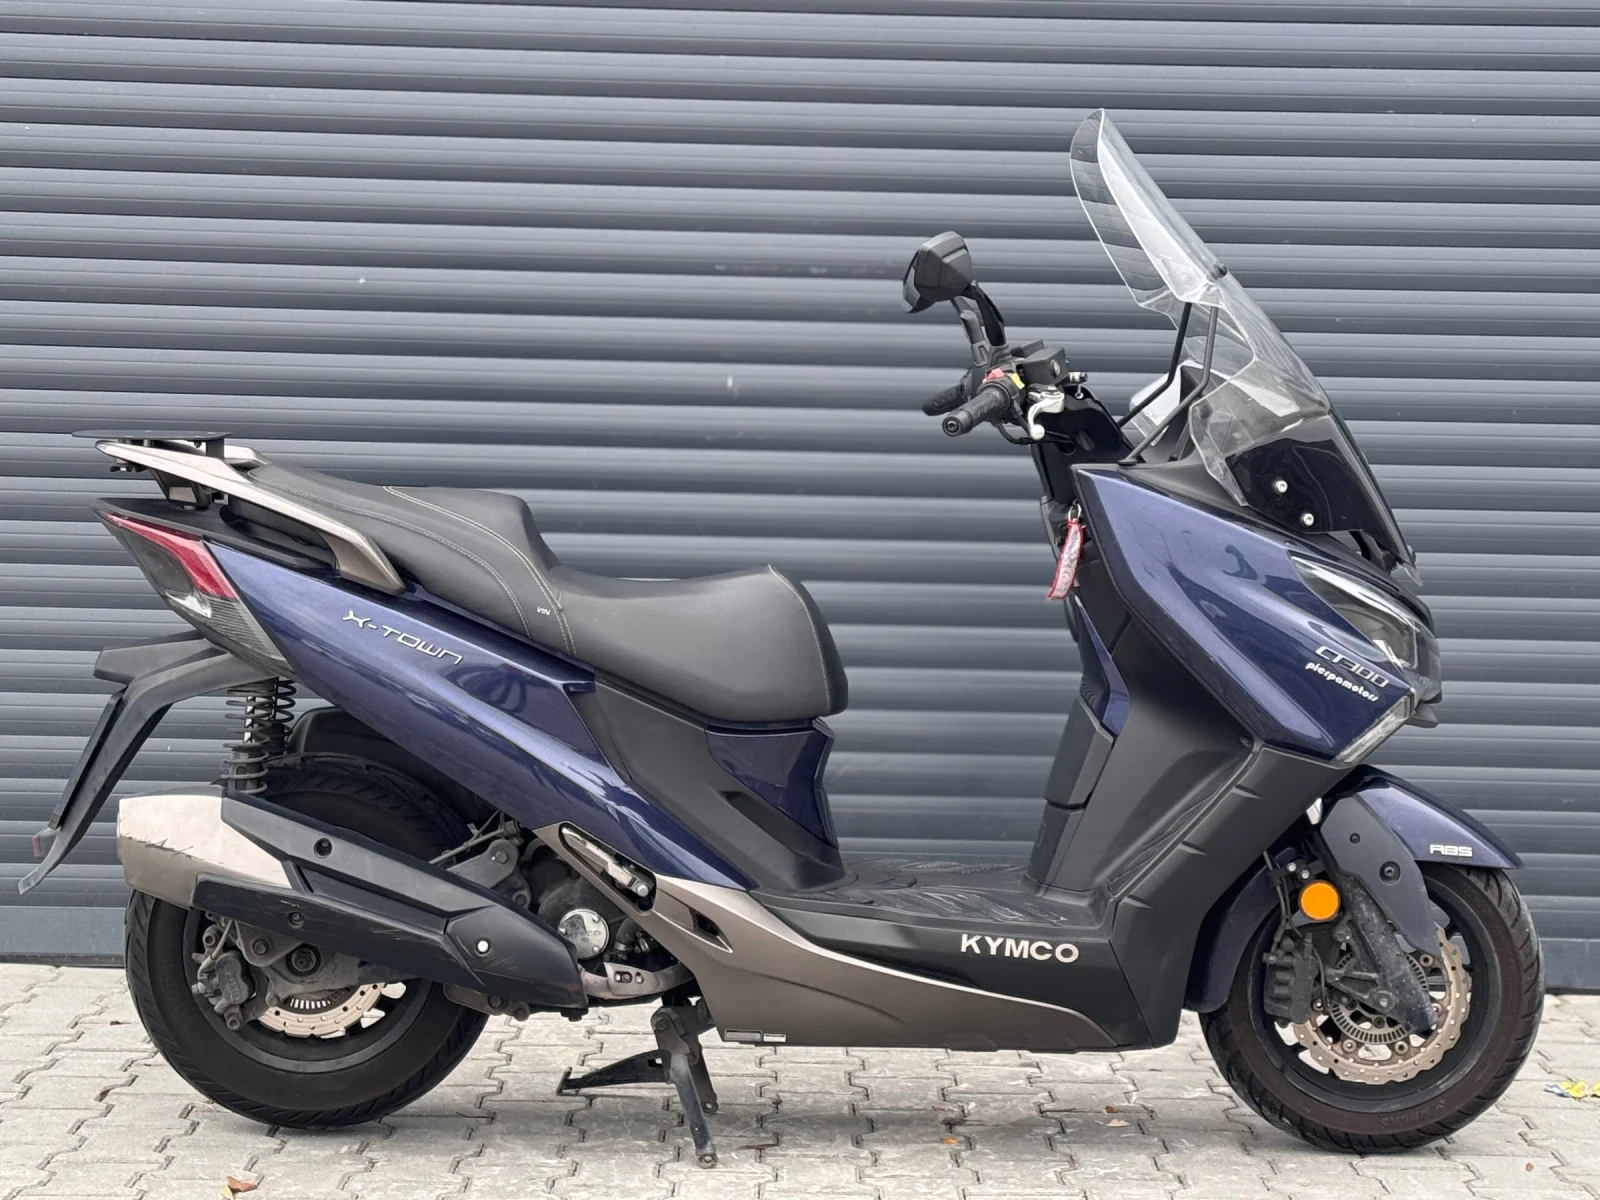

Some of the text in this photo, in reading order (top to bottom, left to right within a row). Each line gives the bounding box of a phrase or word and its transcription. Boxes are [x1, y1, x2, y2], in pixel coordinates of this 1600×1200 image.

[342, 609, 463, 664] X-TOWN
[1305, 662, 1379, 702] pierpamotors
[1315, 645, 1389, 687] CT300
[1430, 844, 1473, 857] ABS
[960, 933, 1079, 963] KYMCO
